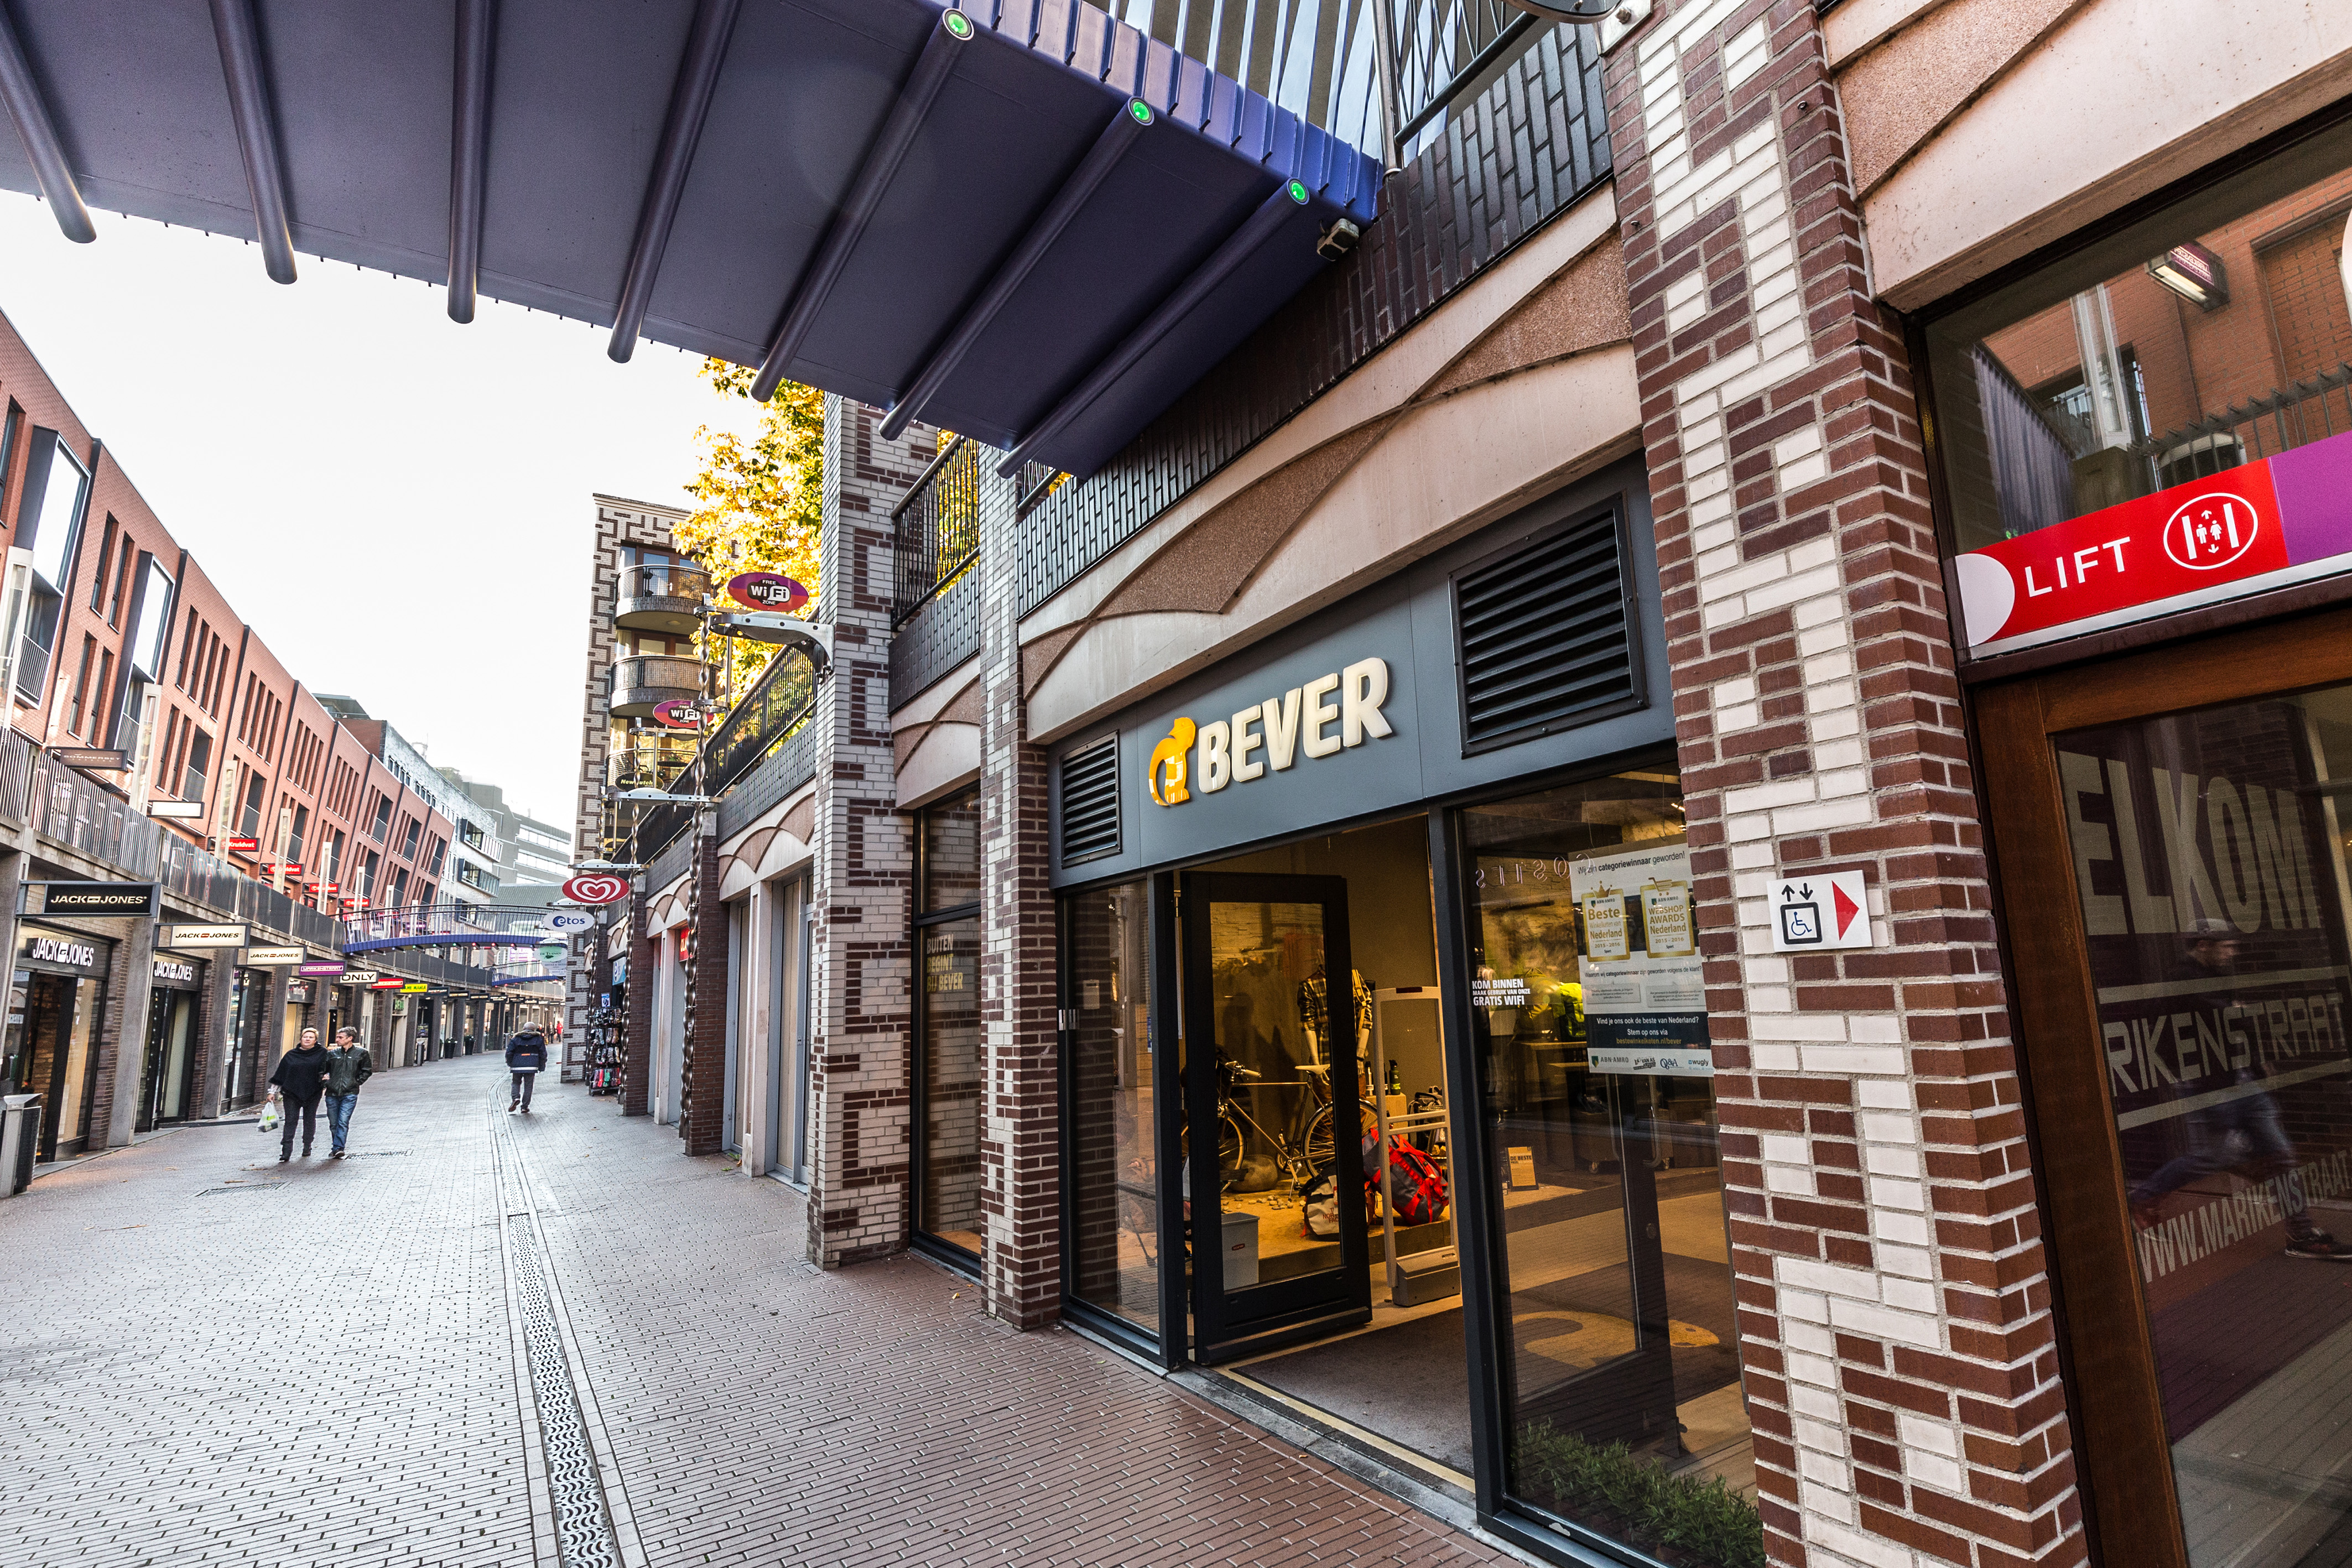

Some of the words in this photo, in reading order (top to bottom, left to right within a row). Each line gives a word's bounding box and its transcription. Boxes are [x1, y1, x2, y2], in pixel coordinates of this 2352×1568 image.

[2025, 536, 2130, 597] LIFT
[1198, 657, 1392, 793] BEVER
[2058, 751, 2321, 936] ELKOM
[1578, 867, 1586, 876] Wij
[1587, 865, 1597, 875] zijn
[1598, 856, 1651, 872] categoriewinnaar
[1652, 851, 1685, 865] geworden!
[51, 895, 87, 904] JACK
[1588, 908, 1621, 920] Beste
[1648, 905, 1684, 915] WEBSHOP
[553, 915, 585, 928] etos
[1649, 913, 1685, 924] AWARDS
[1590, 928, 1622, 940] Nederland
[1650, 923, 1687, 935] Nederland
[32, 937, 60, 961] JACK
[66, 943, 94, 967] JONES
[927, 934, 953, 954] BUITEN
[154, 961, 171, 979] JACK
[175, 965, 193, 981] JONES
[927, 954, 954, 973] BEGINT
[927, 975, 937, 992] BIJ
[939, 972, 963, 991] BEVER
[1472, 980, 1491, 989] KOM
[1492, 978, 1524, 989] BINNEN
[1473, 996, 1503, 1006] GRATIS
[1504, 995, 1525, 1006] WIFI
[2103, 993, 2347, 1097] RIKENSTRAAT
[1660, 1058, 1678, 1070] Q&A
